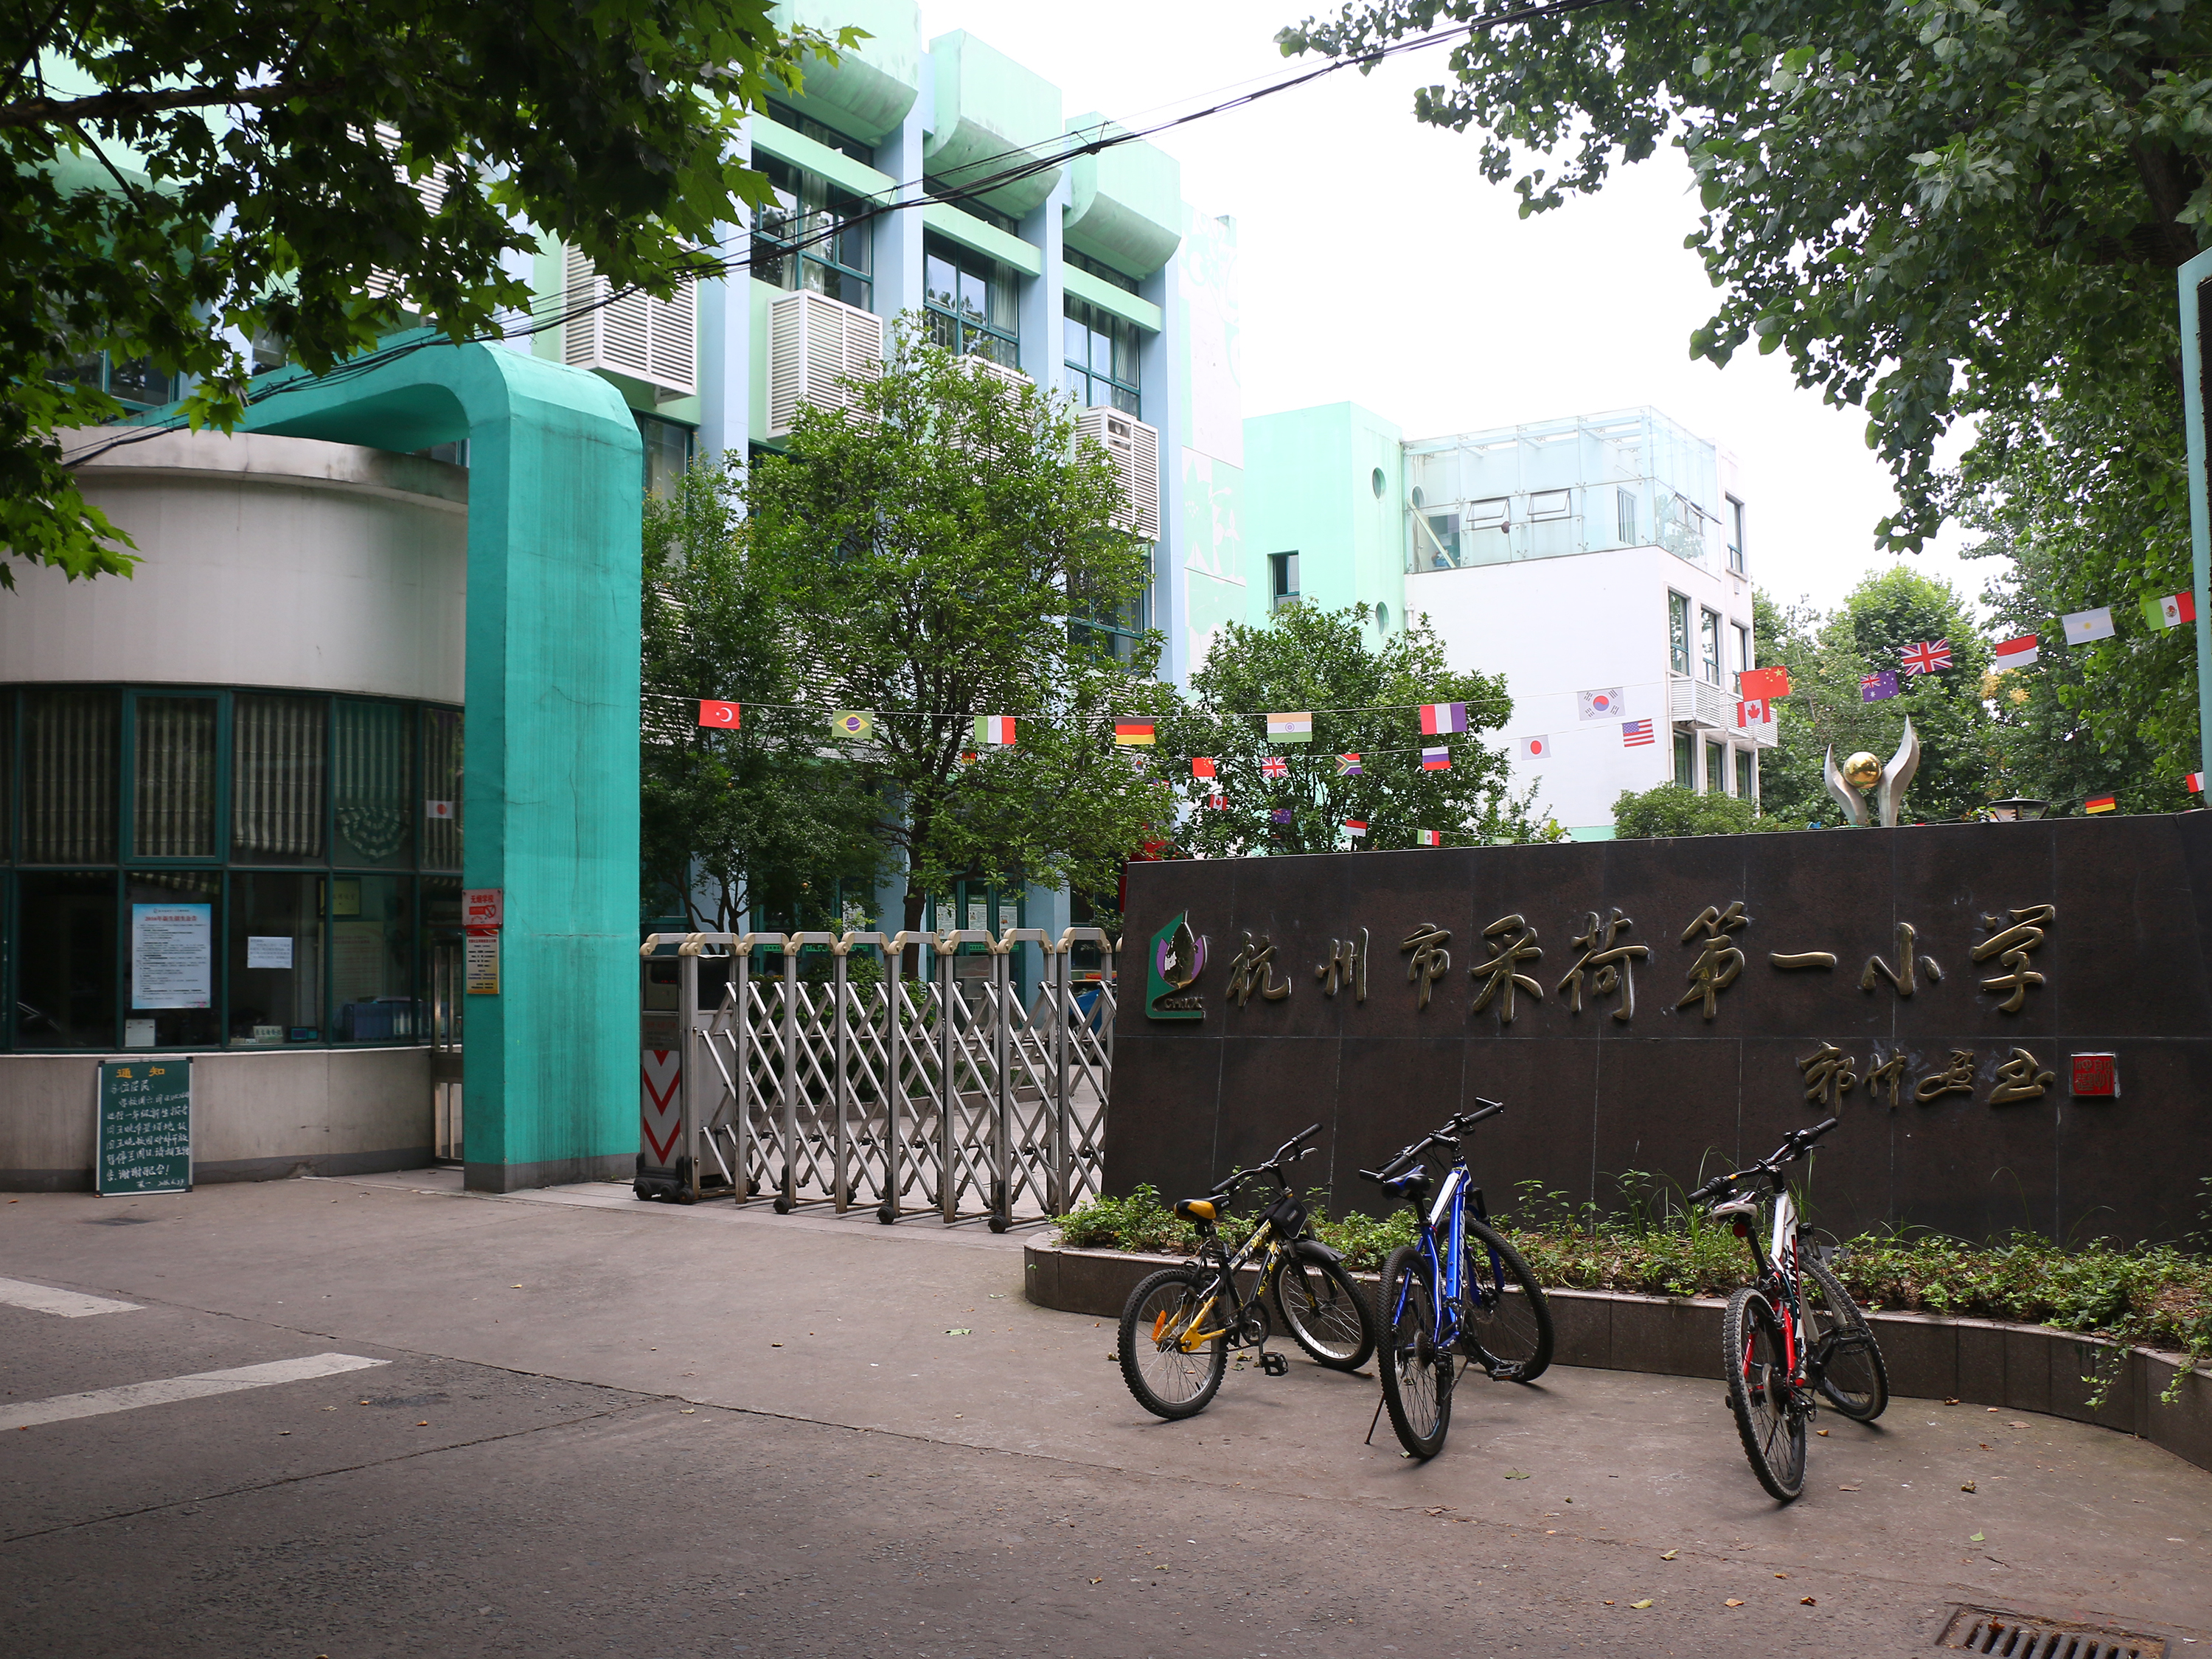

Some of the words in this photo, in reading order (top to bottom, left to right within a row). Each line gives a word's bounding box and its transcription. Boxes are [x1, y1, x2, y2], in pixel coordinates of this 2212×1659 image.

[1226, 901, 2056, 1023] 杭州市采荷第一小学
[116, 1066, 166, 1079] 通知
